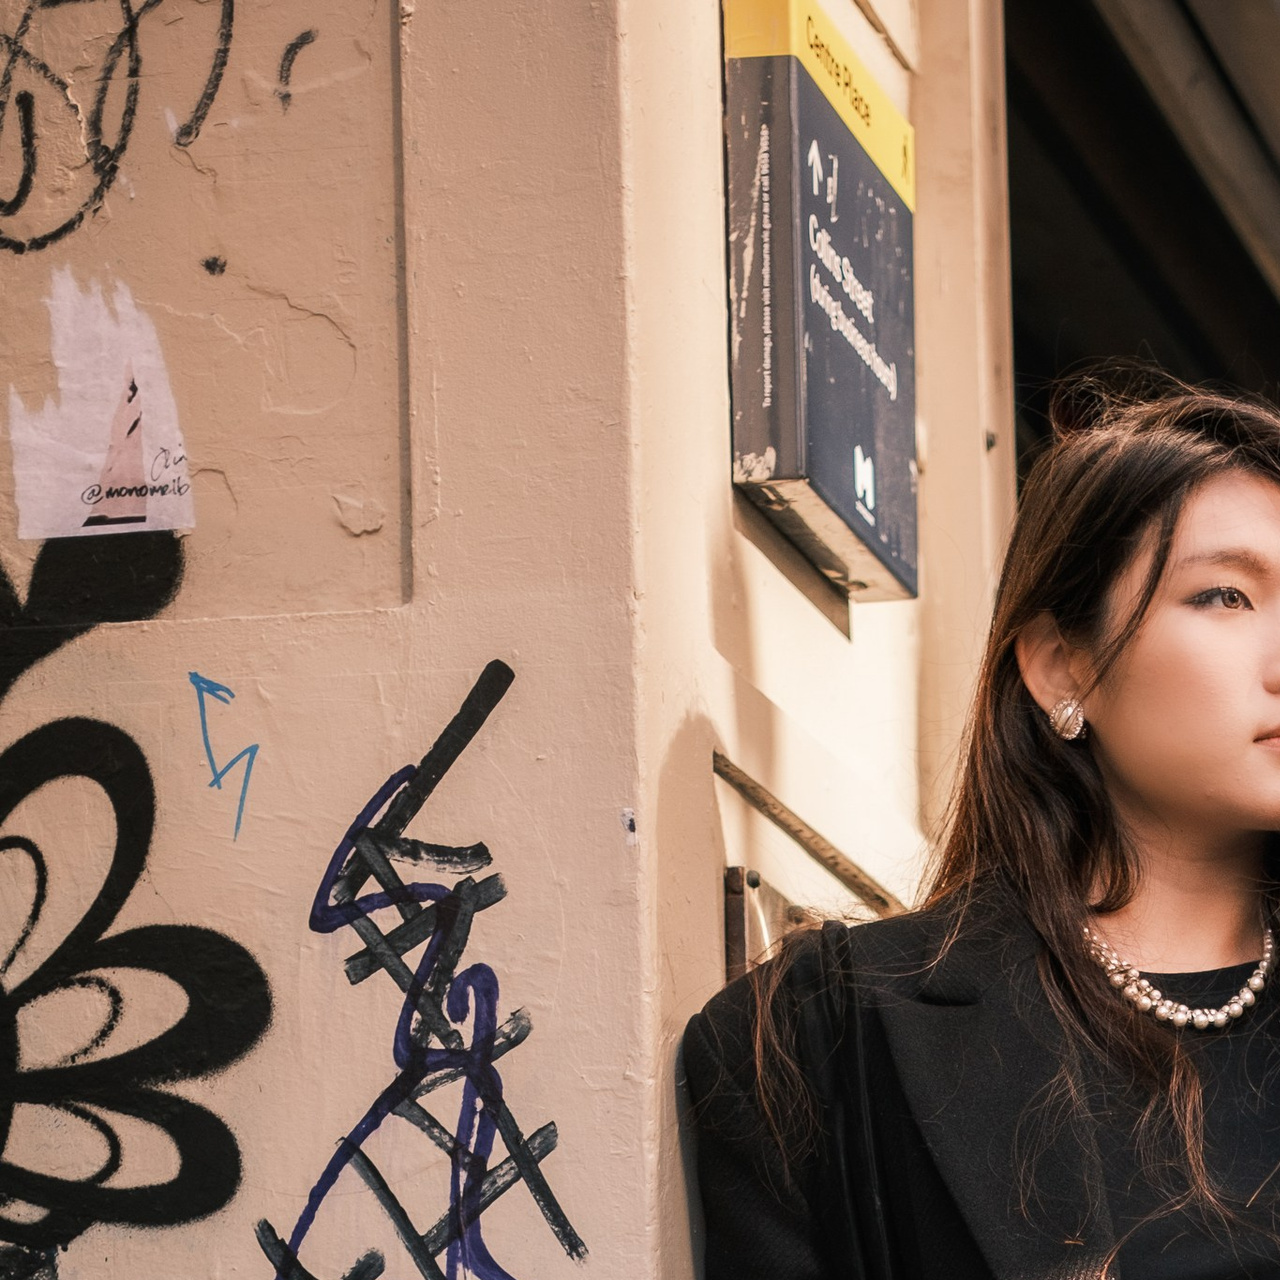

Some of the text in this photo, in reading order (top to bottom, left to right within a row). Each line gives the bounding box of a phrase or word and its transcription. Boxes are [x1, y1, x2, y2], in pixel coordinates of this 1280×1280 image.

[806, 16, 871, 127] Centre Place
[808, 213, 875, 324] Collins Street
[761, 288, 771, 305] visit
[762, 306, 772, 334] please
[762, 371, 772, 396] report
[762, 398, 771, 408] To
